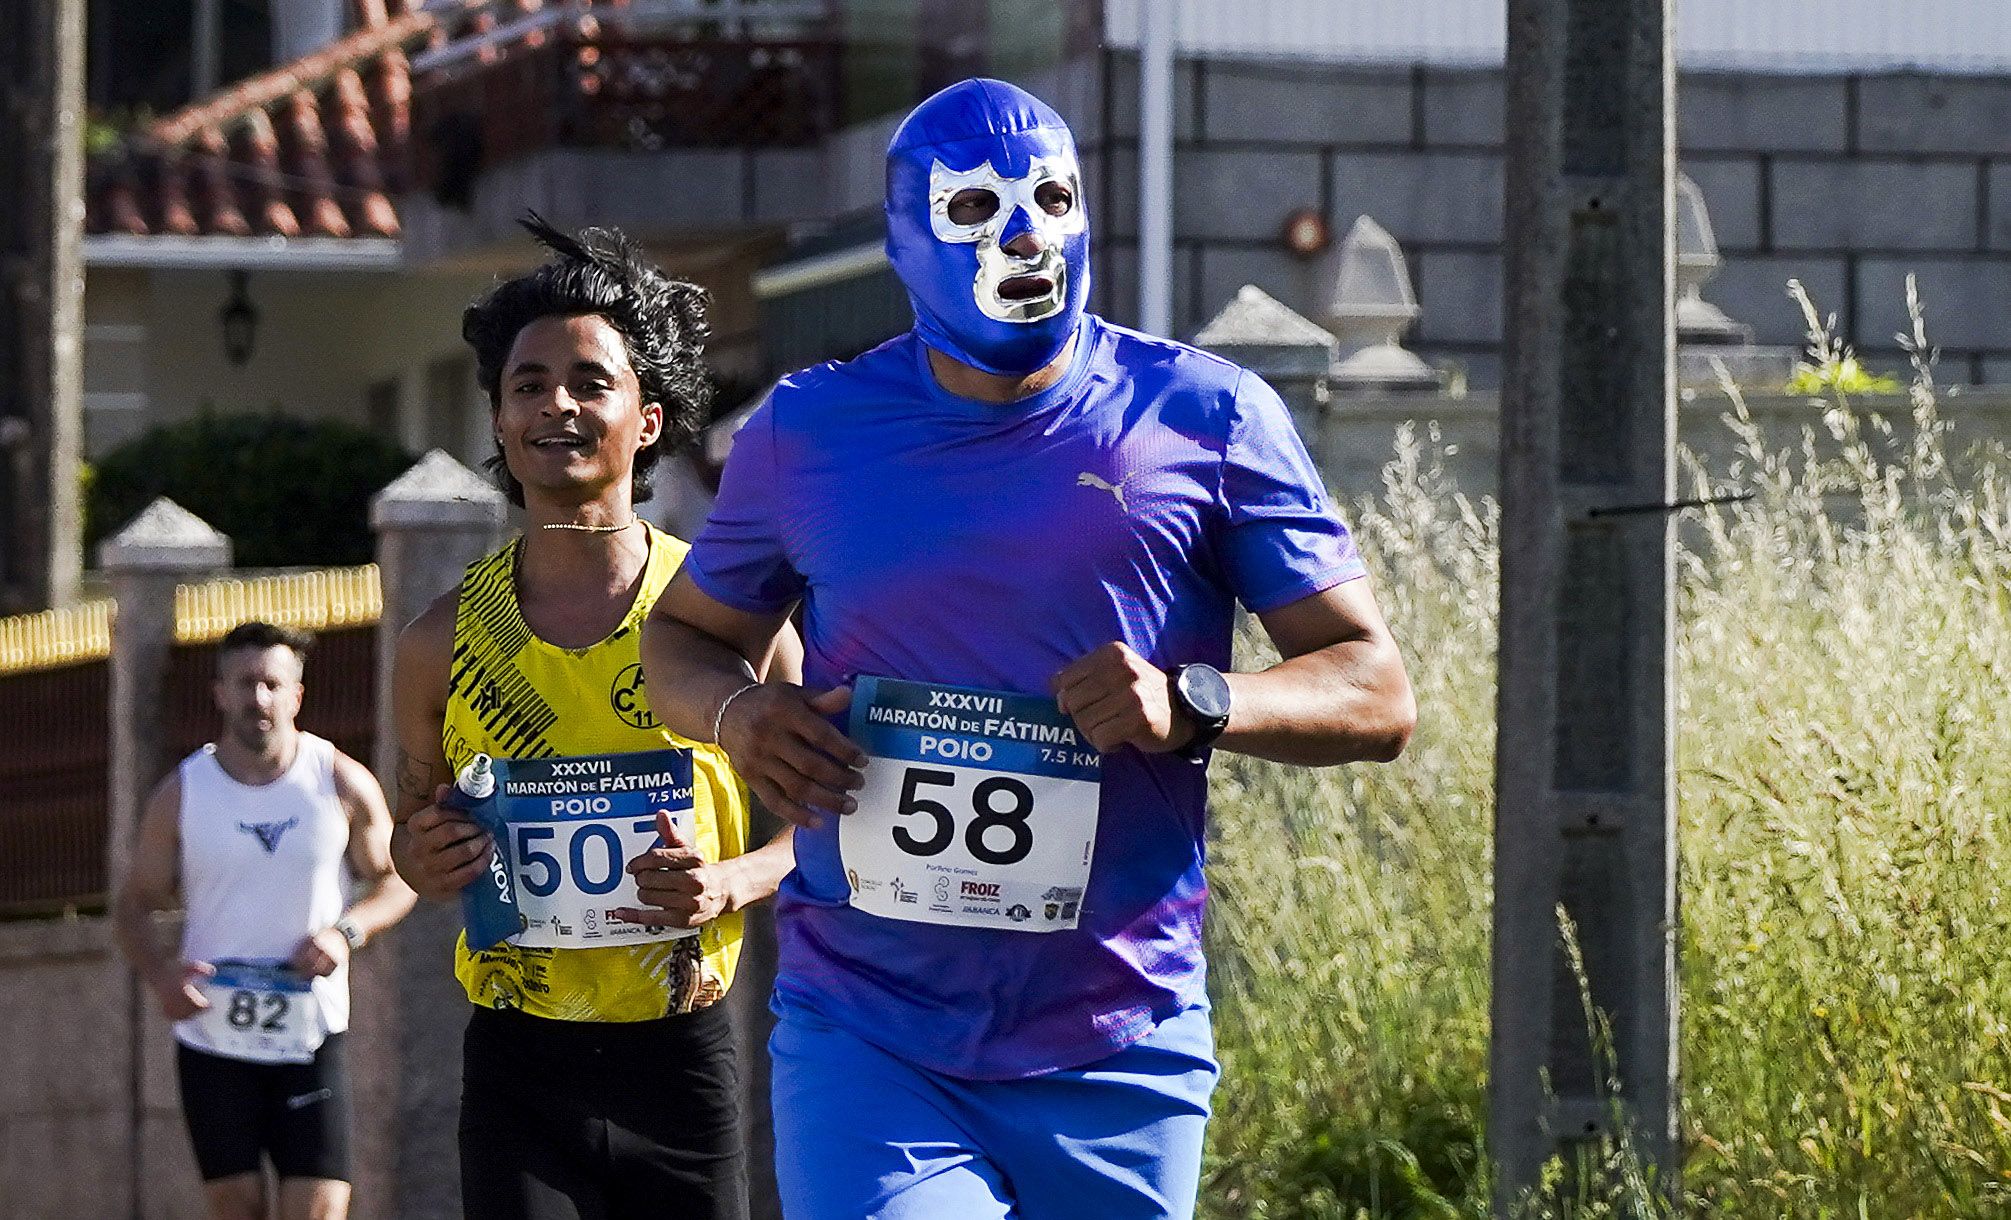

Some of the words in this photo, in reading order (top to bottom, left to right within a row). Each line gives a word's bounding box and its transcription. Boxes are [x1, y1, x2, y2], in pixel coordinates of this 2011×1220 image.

[929, 691, 1002, 713] XXXVII
[869, 706, 956, 731] MARATÓN
[960, 720, 980, 732] DE
[984, 717, 1077, 745] FÁTIMA
[920, 735, 993, 761] POIO
[1041, 748, 1067, 763] 7.5
[1072, 750, 1100, 767] KM
[551, 760, 612, 776] XXXVII
[507, 778, 578, 795] MARATÓN
[580, 782, 597, 792] DE
[600, 771, 674, 793] FÁTIMA
[551, 797, 612, 816] POIO
[648, 791, 670, 804] 7.5
[672, 787, 694, 800] KM
[892, 767, 1034, 865] 58
[960, 881, 1001, 897] FROIZ
[229, 990, 289, 1032] 82
